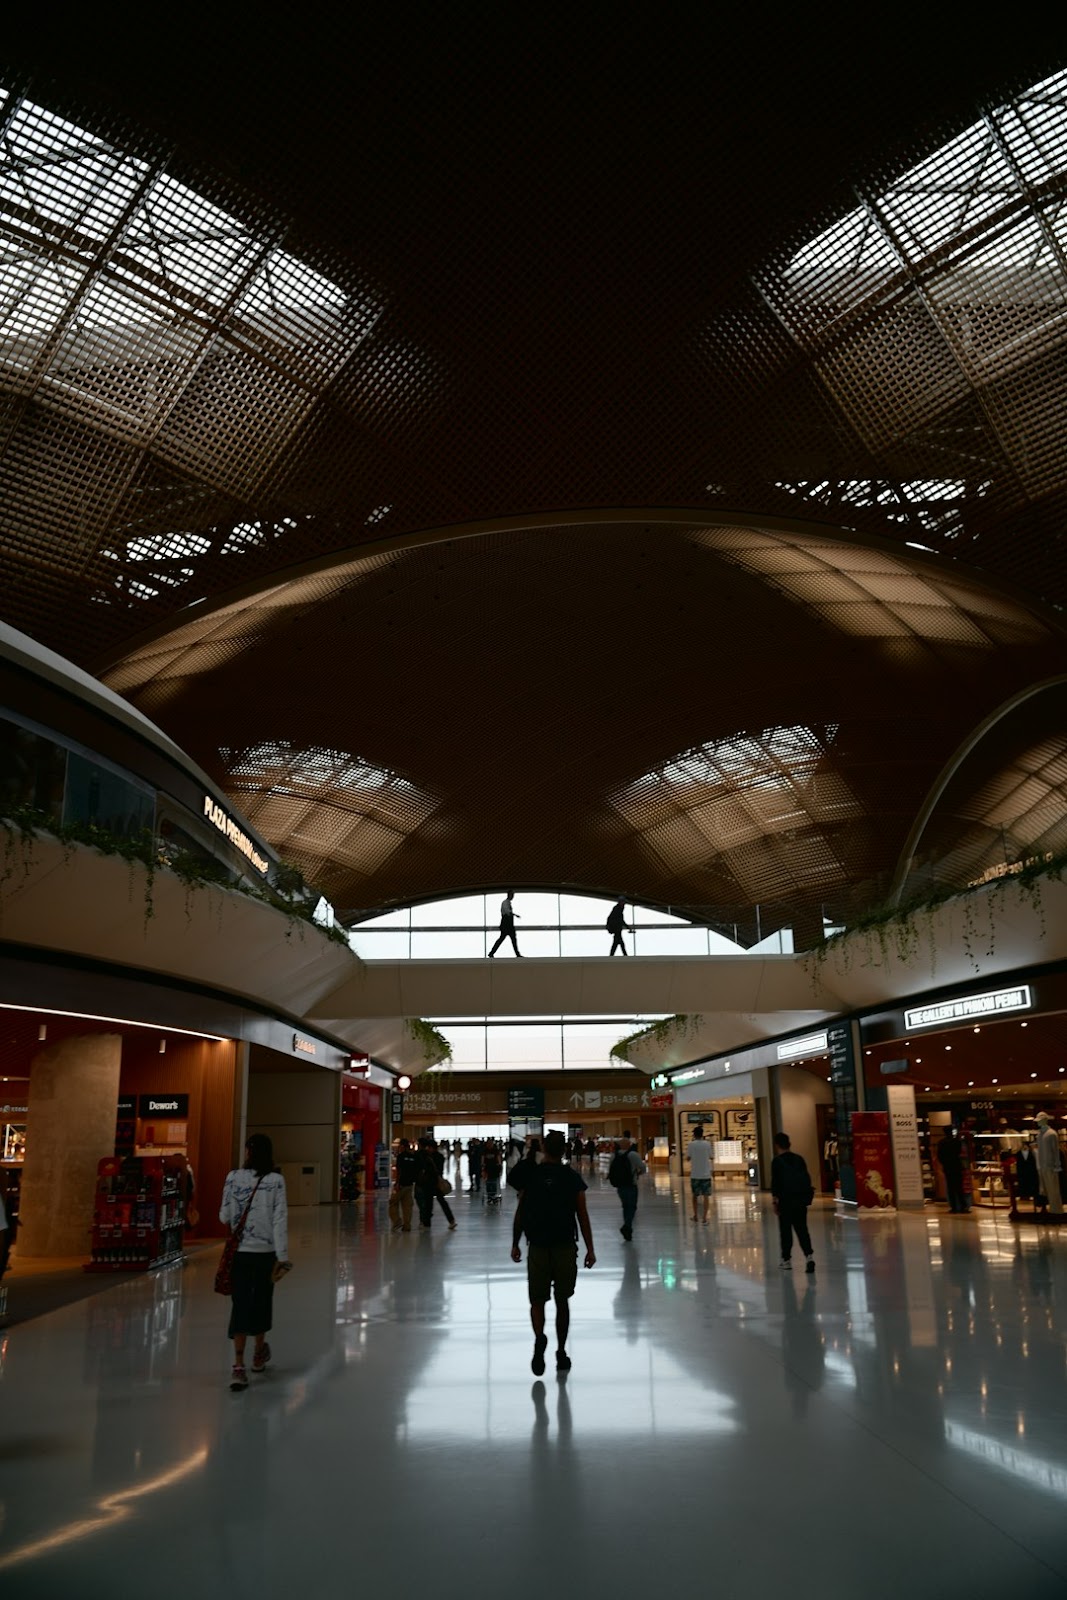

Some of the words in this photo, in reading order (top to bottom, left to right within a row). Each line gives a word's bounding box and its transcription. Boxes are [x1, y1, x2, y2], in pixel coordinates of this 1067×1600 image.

[204, 795, 227, 834] PLAZA
[923, 1005, 954, 1022] GALLERY
[149, 1101, 178, 1110] Dewar's
[971, 1101, 994, 1109] BOSS
